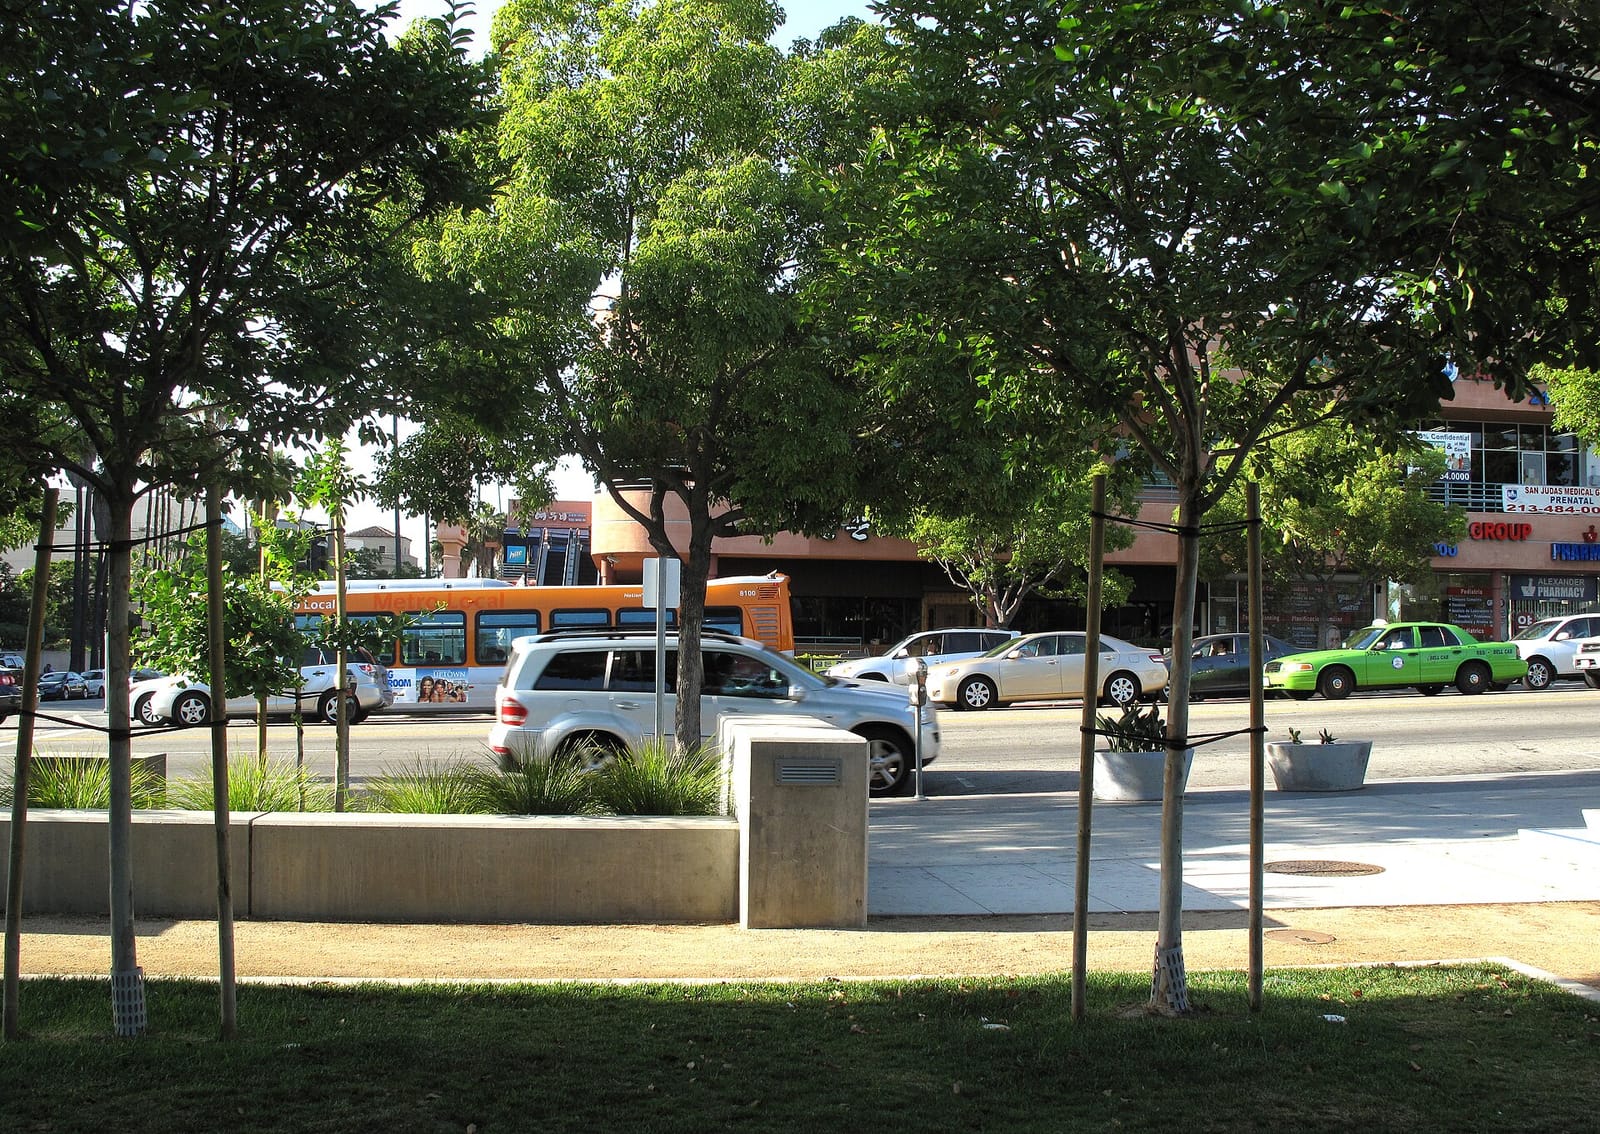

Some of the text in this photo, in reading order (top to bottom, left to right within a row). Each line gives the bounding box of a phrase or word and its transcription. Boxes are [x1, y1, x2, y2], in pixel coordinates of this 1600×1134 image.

[1430, 433, 1470, 441] Confidential
[1524, 486, 1539, 494] SAN
[1540, 487, 1563, 495] JUDAS
[1564, 488, 1594, 496] MEDICAL
[1595, 489, 1600, 497] G
[1550, 496, 1594, 505] PRENATAL
[1469, 521, 1532, 541] GROUP
[1551, 543, 1600, 561] PHARM
[1537, 577, 1585, 586] ALEXANDER
[1537, 586, 1585, 598] PHARMACY
[304, 599, 336, 610] Local
[373, 592, 505, 610] Metro Local
